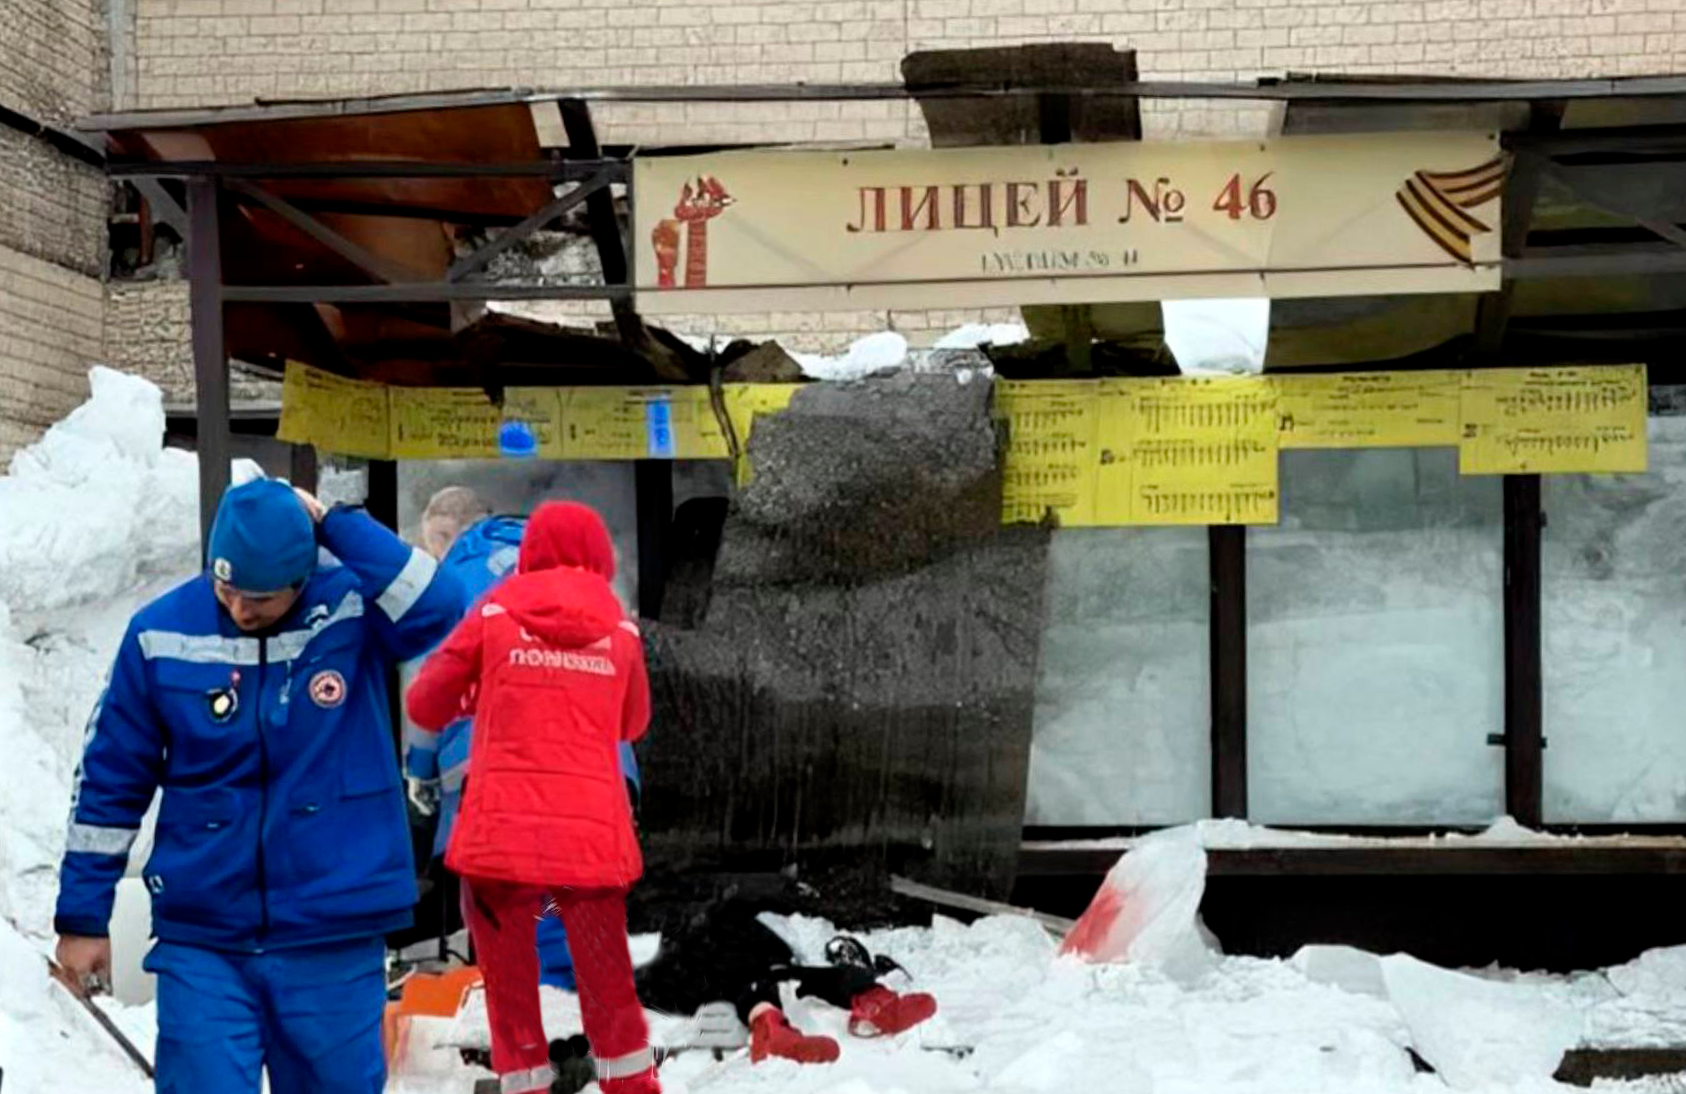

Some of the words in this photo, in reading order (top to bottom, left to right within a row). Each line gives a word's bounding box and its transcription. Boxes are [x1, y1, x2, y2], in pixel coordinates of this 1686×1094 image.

[846, 167, 1091, 238] ЛИЦЕЙ
[1118, 177, 1186, 224] №
[1212, 171, 1279, 222] 46
